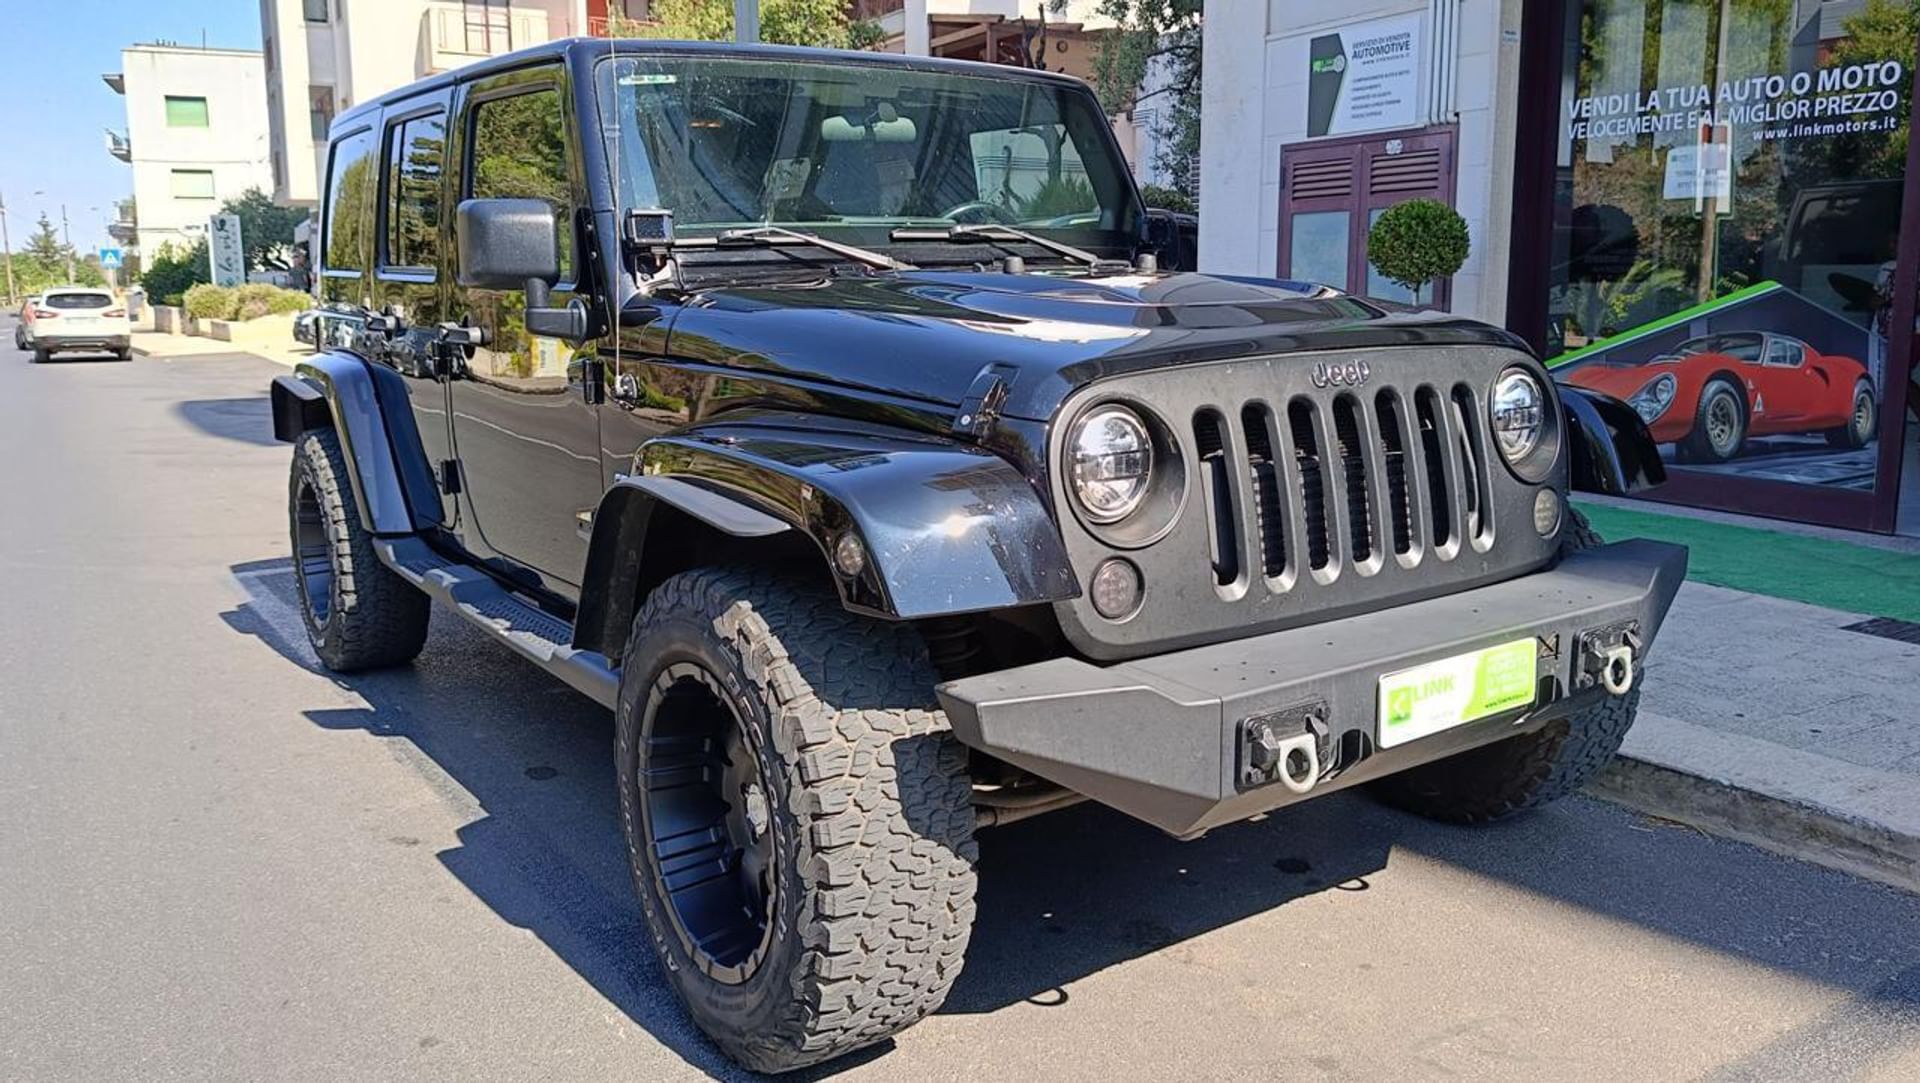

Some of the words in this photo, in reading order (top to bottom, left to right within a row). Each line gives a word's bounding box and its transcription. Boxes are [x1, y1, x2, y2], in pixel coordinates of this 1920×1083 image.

[1352, 40, 1410, 60] AUTOMOTIVE
[1568, 92, 1629, 119] VENDI
[1635, 90, 1661, 112] LA
[1666, 84, 1711, 109] TUA
[1717, 75, 1784, 102] AUTO
[1791, 72, 1810, 95] O
[1817, 61, 1901, 92] MOTO
[1567, 112, 1683, 139] VELOCEMENTE
[1687, 110, 1698, 128] E
[1728, 99, 1809, 124] MIGLIOR
[1814, 90, 1898, 117] PREZZO
[1752, 116, 1896, 140] www.linkmotors.it
[1311, 359, 1370, 388] Jeep
[1414, 674, 1456, 701] LINK
